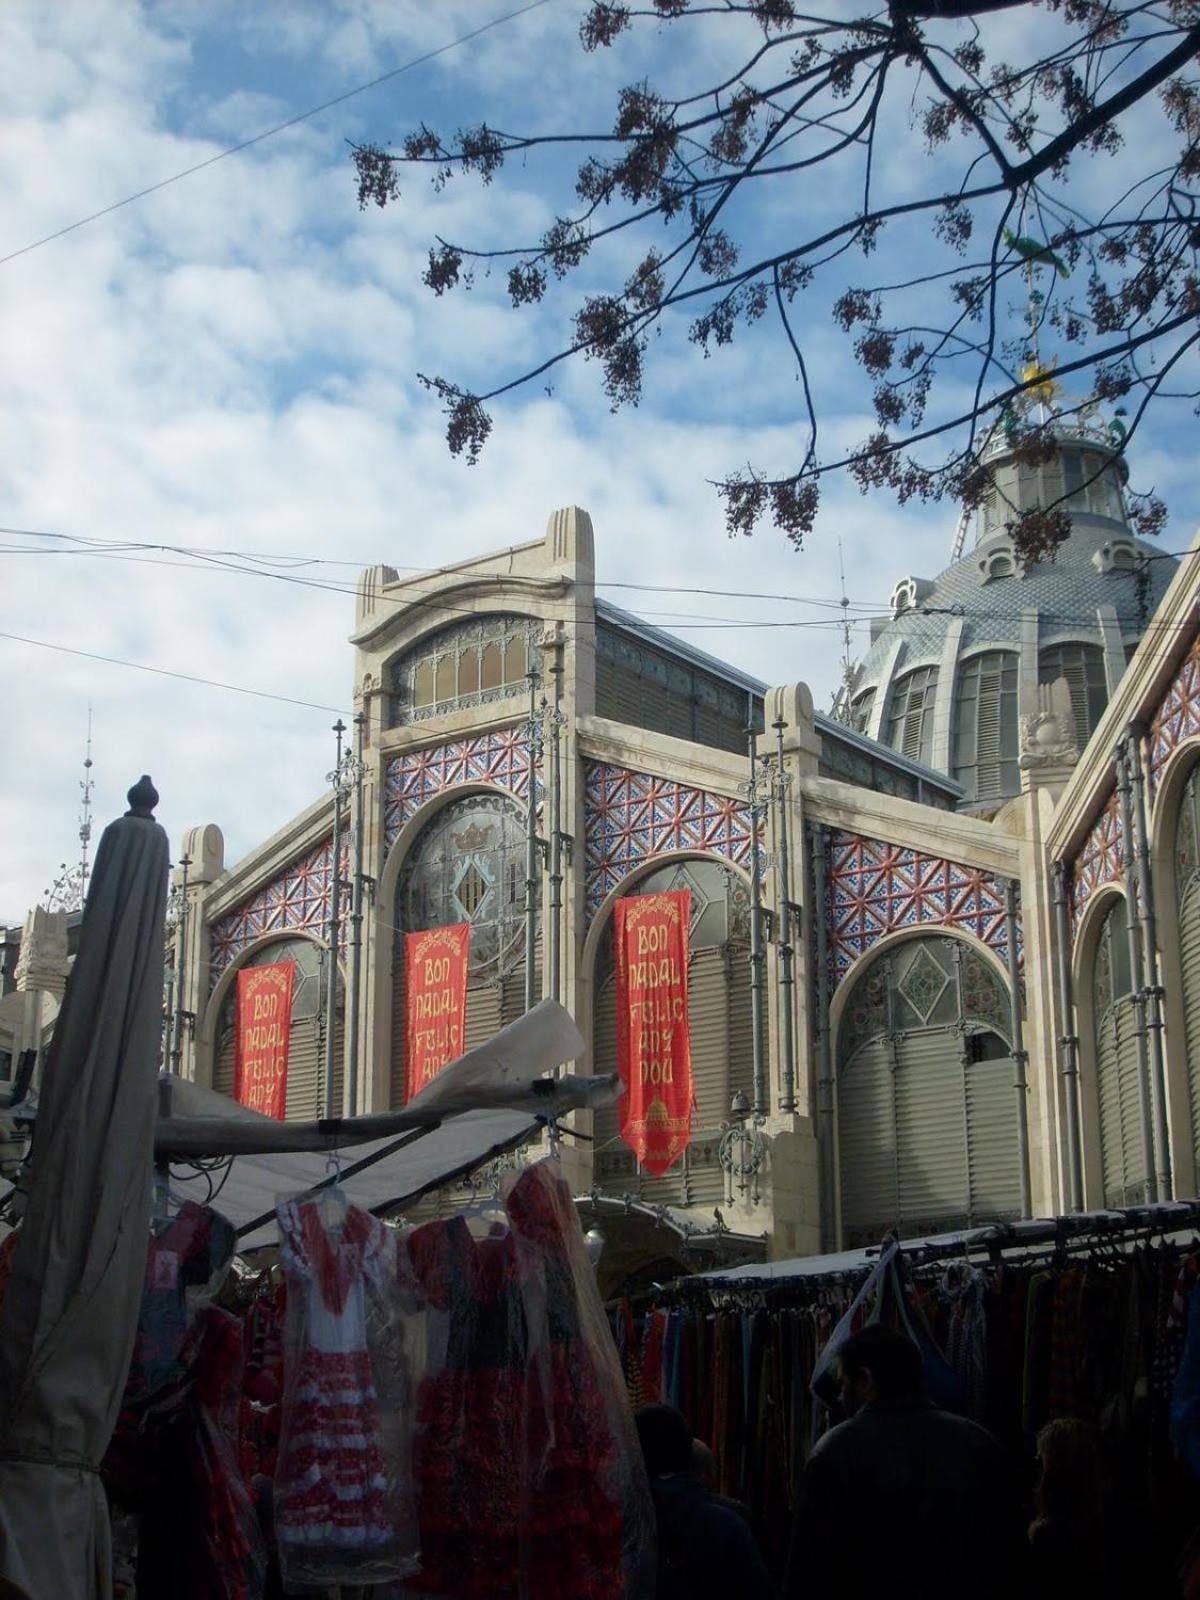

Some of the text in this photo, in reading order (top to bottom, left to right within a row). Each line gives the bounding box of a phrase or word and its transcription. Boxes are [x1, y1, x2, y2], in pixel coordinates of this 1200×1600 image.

[638, 925, 668, 955] BON
[424, 957, 450, 986] BON
[628, 958, 681, 990] NADAL
[254, 994, 278, 1020] BON
[415, 987, 458, 1019] NADAL
[245, 1022, 285, 1052] NADAL
[639, 1058, 674, 1086] NOU
